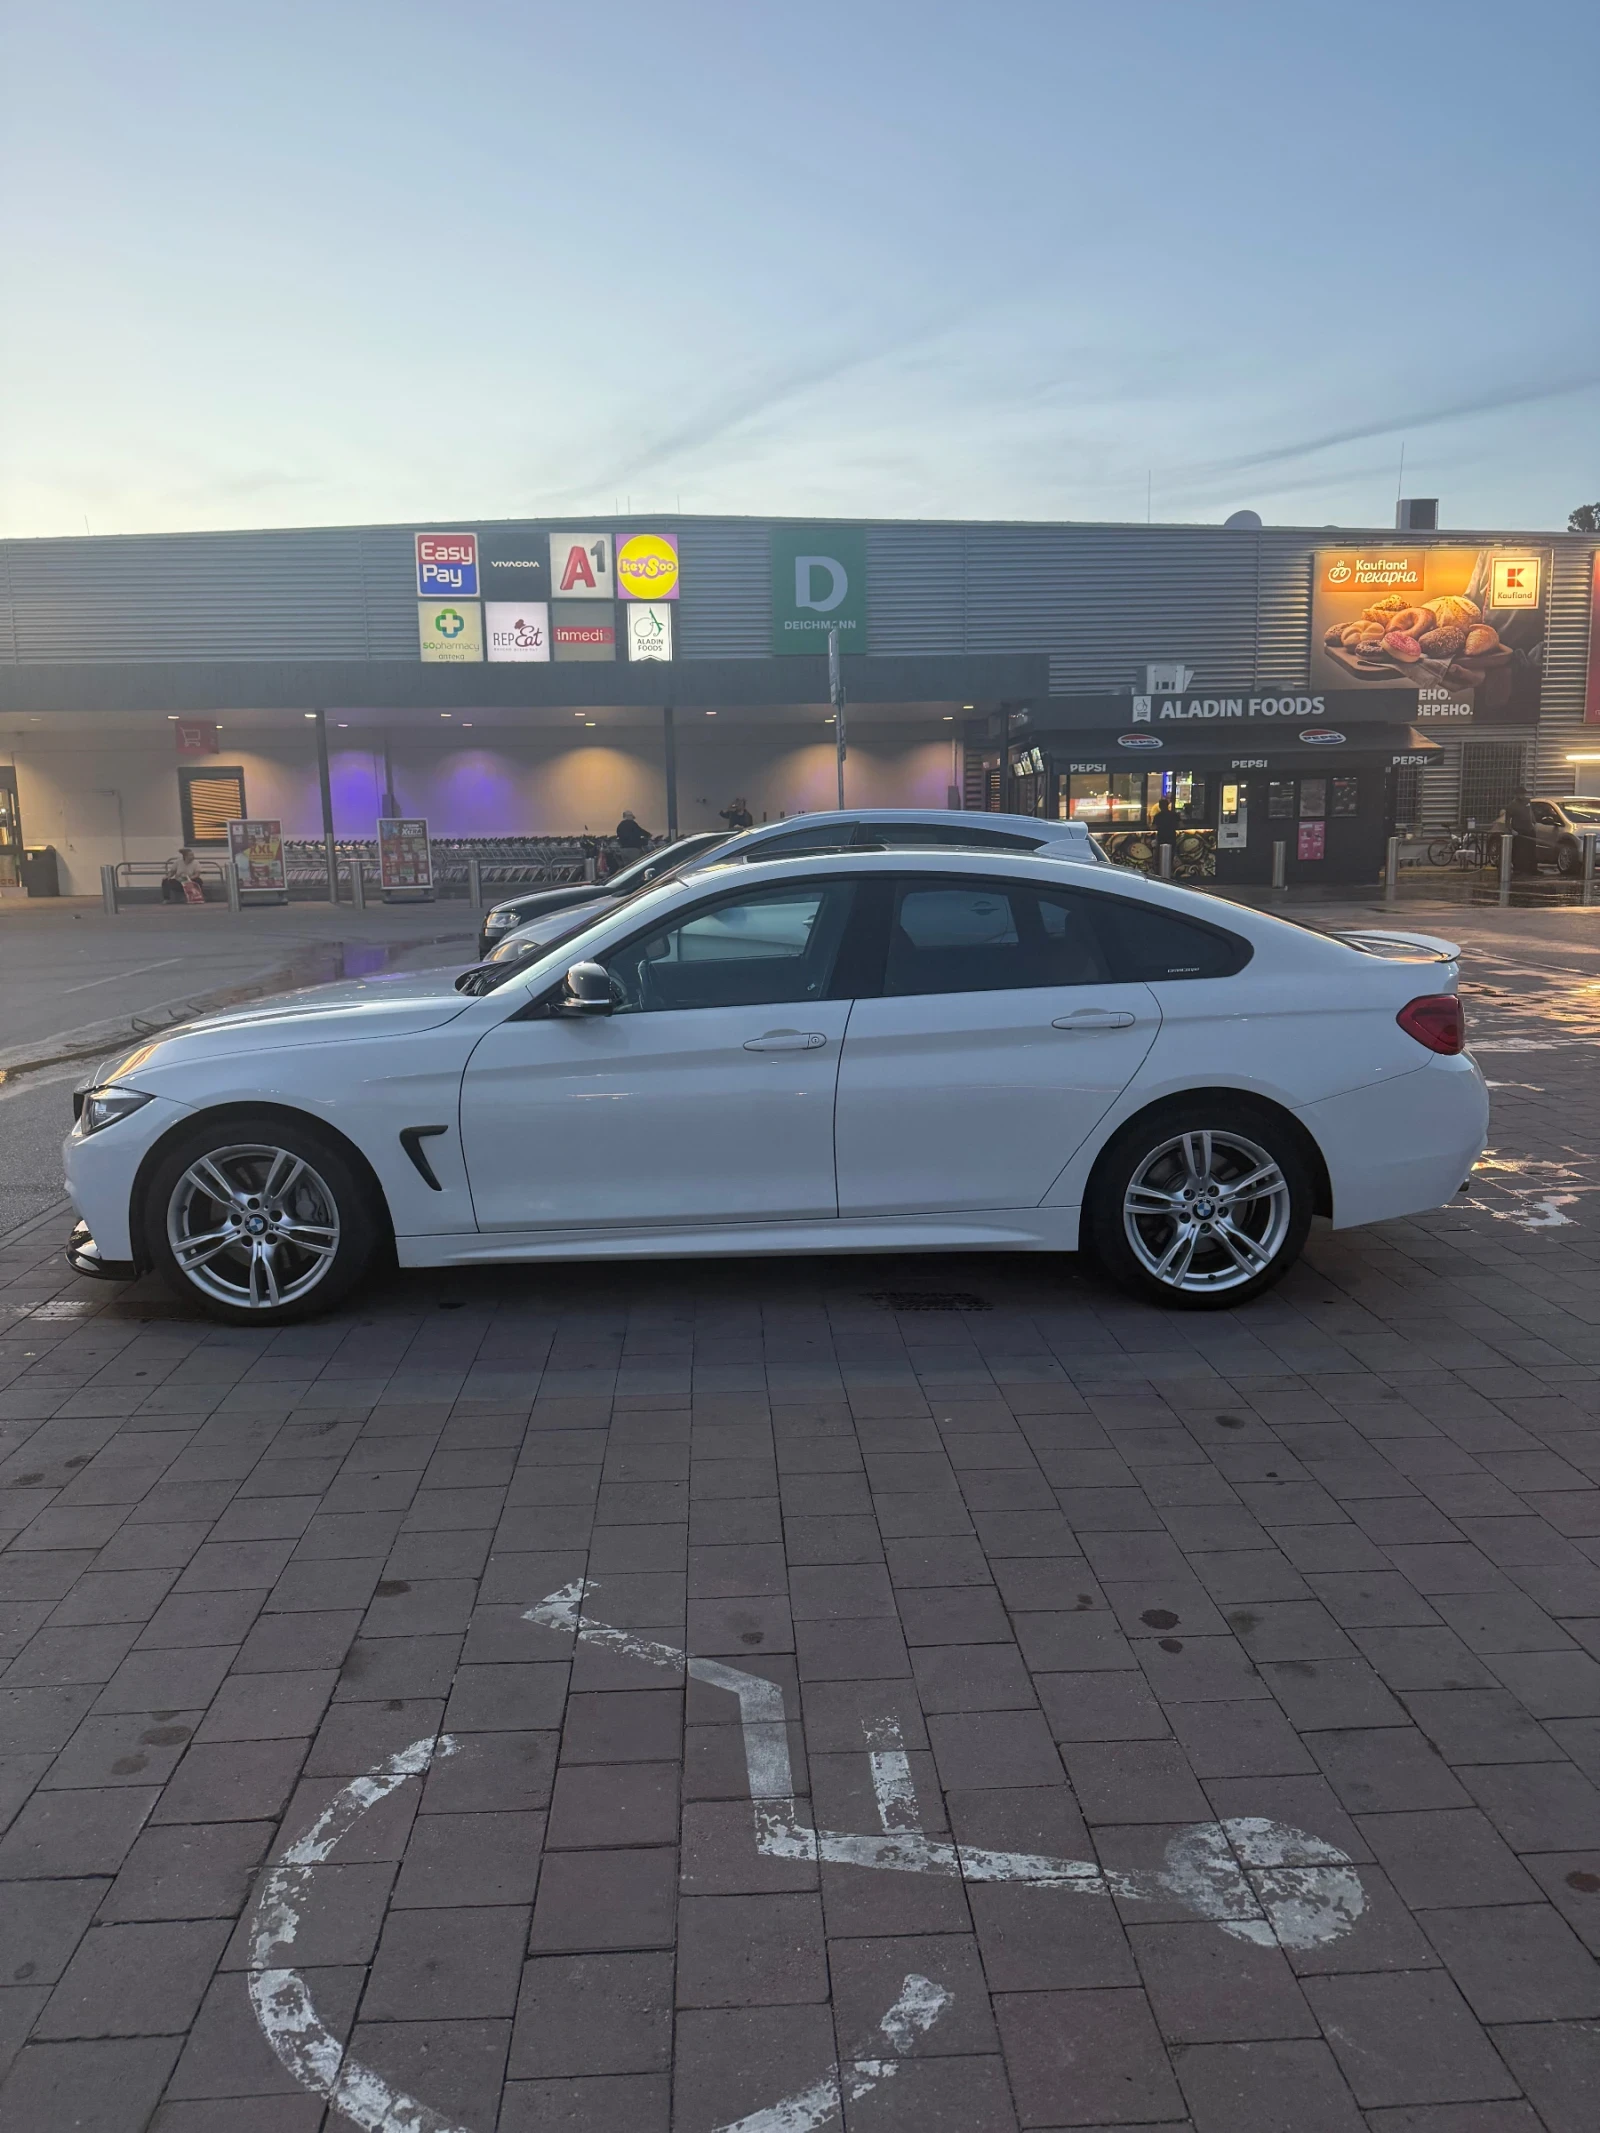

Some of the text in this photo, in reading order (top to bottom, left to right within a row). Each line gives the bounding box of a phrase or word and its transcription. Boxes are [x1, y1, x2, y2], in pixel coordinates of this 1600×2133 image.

[421, 542, 473, 565] Easy
[560, 540, 606, 590] A1
[622, 558, 674, 577] keySoo
[1356, 559, 1408, 571] Kaufland
[422, 564, 462, 588] Pay
[1354, 571, 1418, 586] пекарна
[795, 556, 848, 612] D
[557, 629, 612, 641] inmedio
[422, 641, 480, 652] sopharmacy
[1159, 697, 1325, 719] ALADIN FOODS
[1070, 763, 1107, 772] PEPSI
[1231, 759, 1268, 769] PEPSI
[1392, 755, 1428, 765] PEPSI
